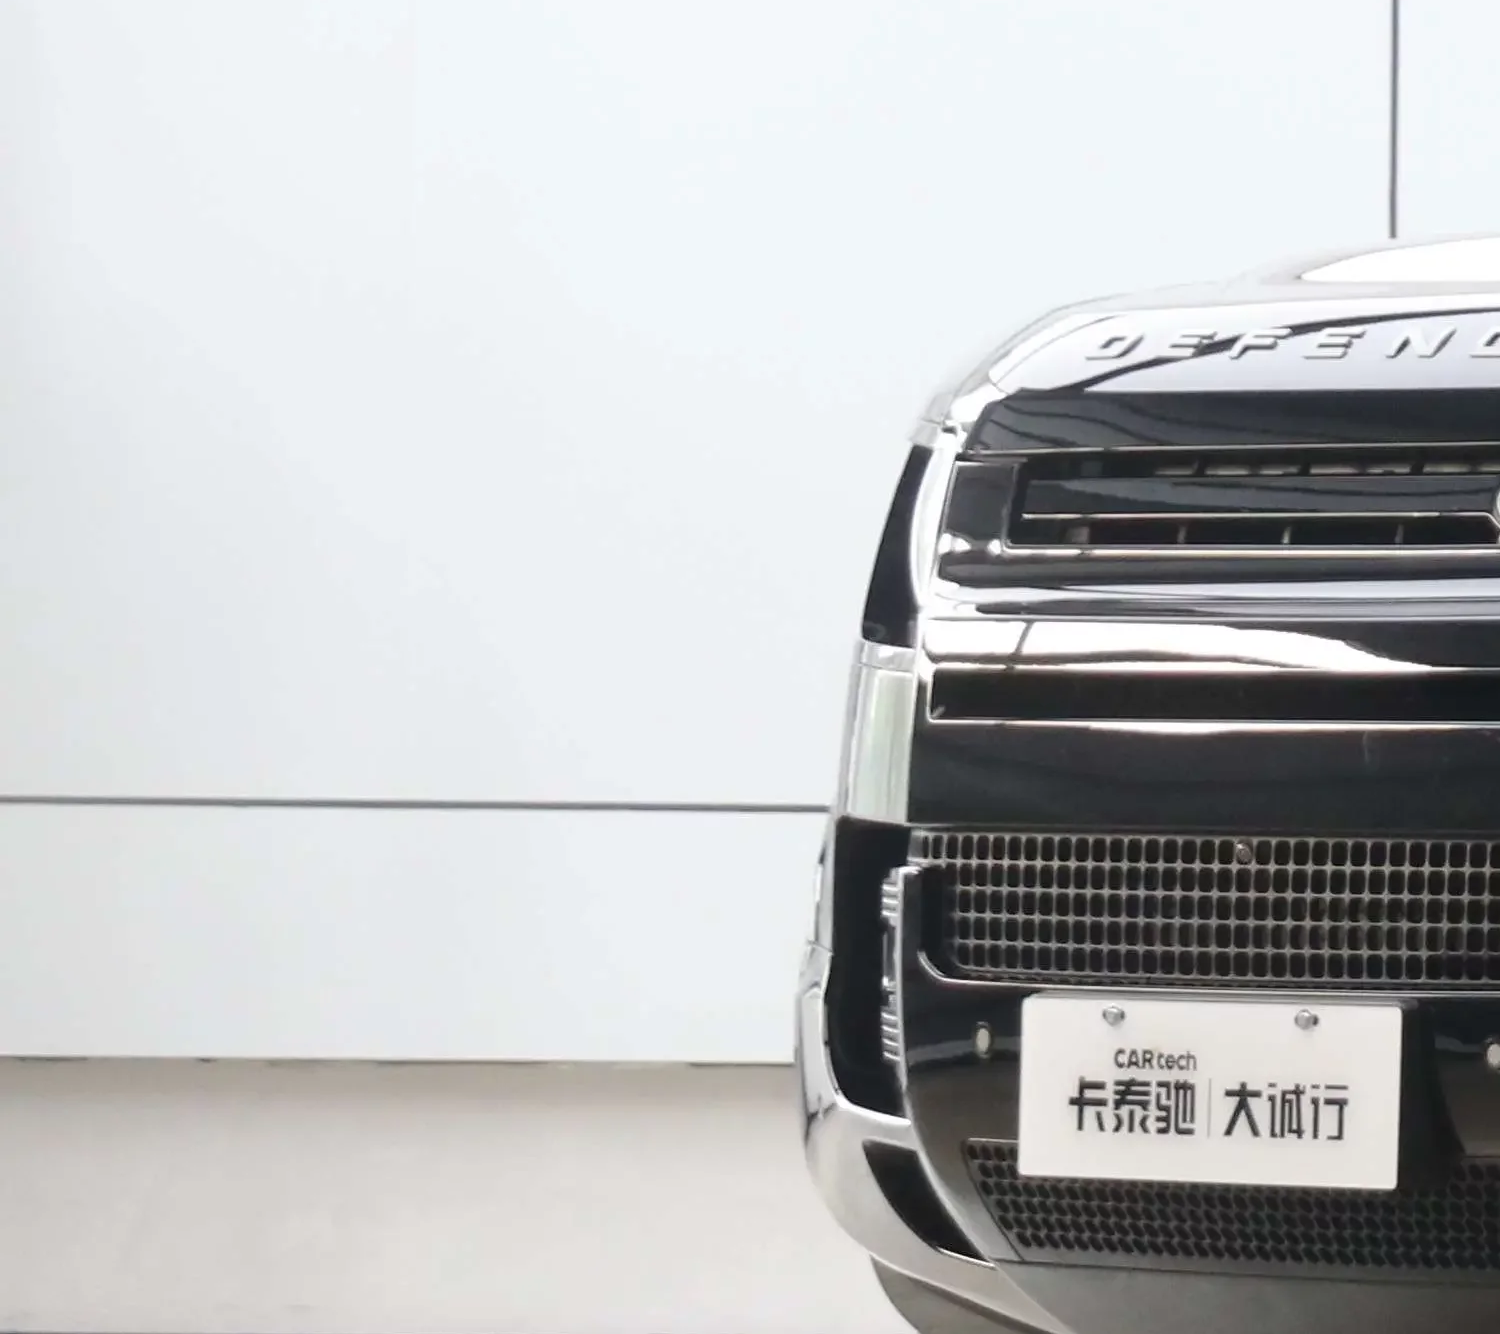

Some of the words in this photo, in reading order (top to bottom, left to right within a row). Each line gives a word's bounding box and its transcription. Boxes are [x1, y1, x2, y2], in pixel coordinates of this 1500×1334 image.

[1114, 1048, 1197, 1071] CARtech
[1068, 1076, 1196, 1136] 卡泰驰
[1223, 1081, 1349, 1141] 大诚行
